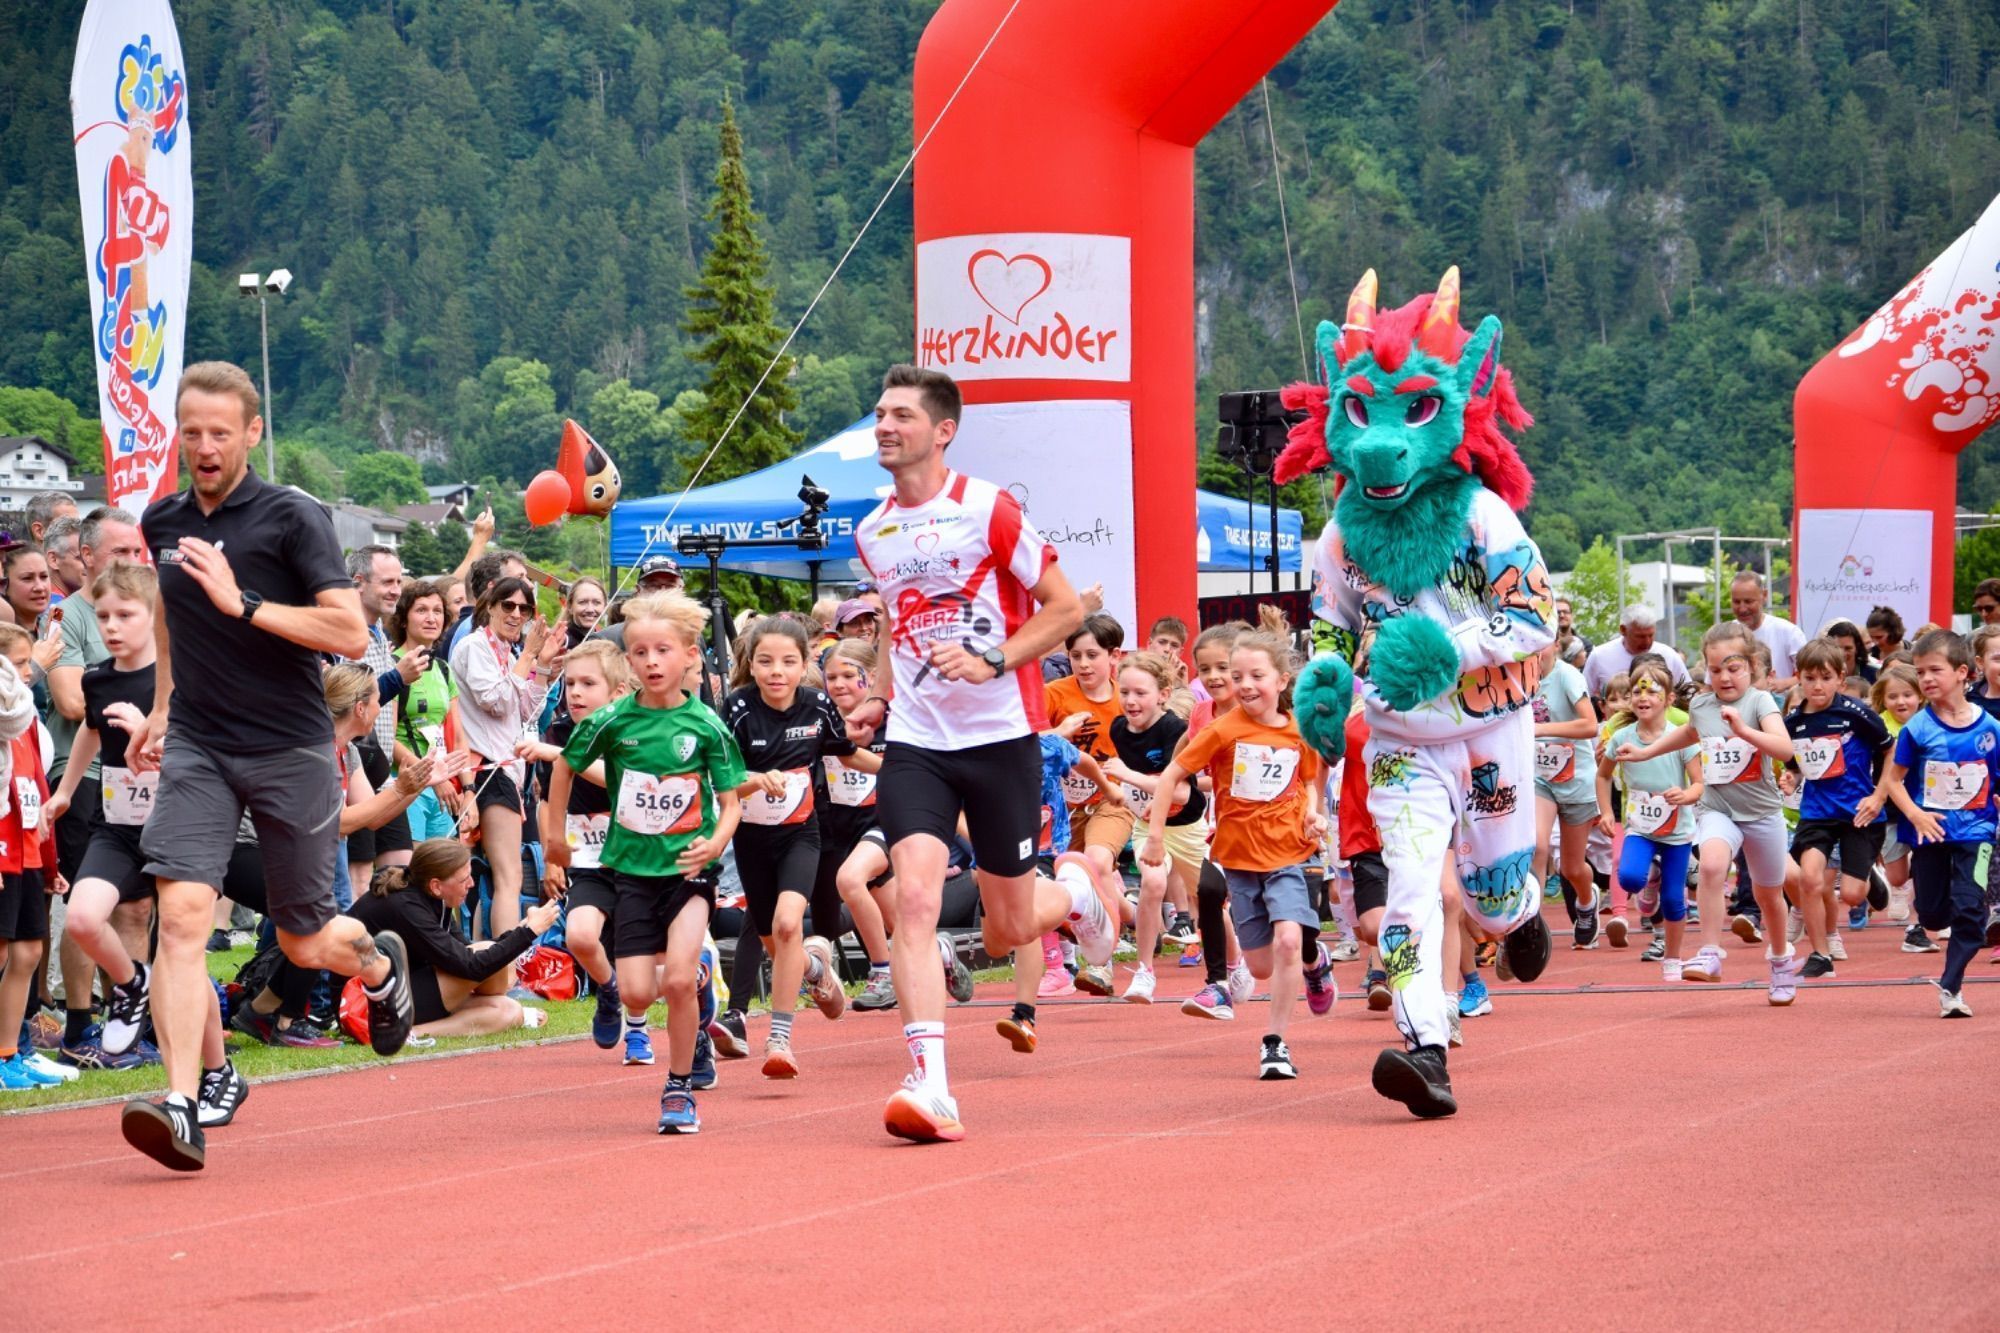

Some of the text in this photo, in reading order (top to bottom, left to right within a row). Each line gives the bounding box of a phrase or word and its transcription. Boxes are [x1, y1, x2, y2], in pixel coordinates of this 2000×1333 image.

[910, 608, 959, 631] HERZ
[920, 624, 959, 644] LAUF
[1536, 754, 1559, 766] 124
[1714, 750, 1741, 764] 133
[1804, 750, 1827, 763] 104
[1262, 763, 1283, 778] 72
[842, 772, 868, 785] 135
[1954, 777, 1964, 790] 1
[635, 792, 684, 810] 5166
[1640, 805, 1662, 818] 110
